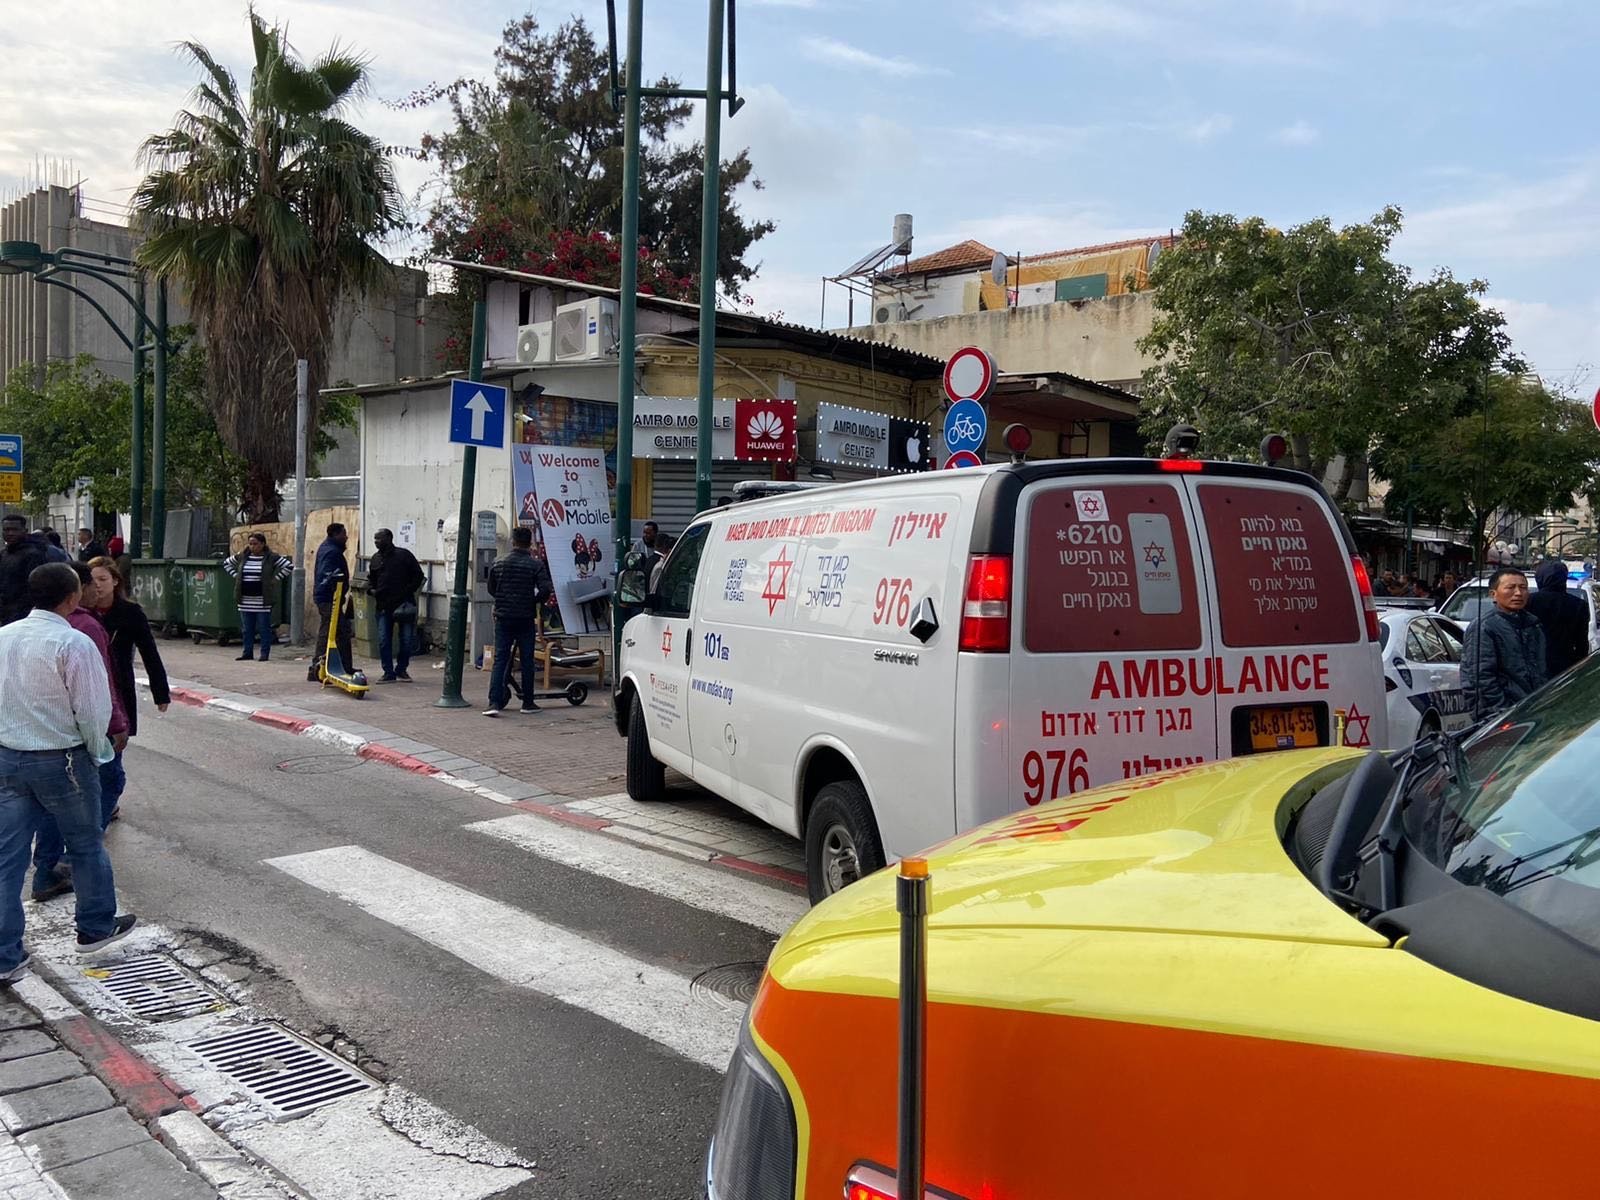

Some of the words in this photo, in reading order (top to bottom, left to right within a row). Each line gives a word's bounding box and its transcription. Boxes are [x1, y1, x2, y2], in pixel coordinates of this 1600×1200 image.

[633, 414, 674, 428] AMRO
[677, 415, 732, 428] MOLE
[833, 420, 857, 435] AMRO
[858, 424, 886, 440] MOBILE
[654, 435, 699, 448] CENTE
[747, 441, 785, 450] HUAWEI
[844, 443, 875, 459] CENTER
[538, 453, 600, 468] Welcome
[564, 469, 579, 482] to
[565, 509, 610, 526] Mobile
[725, 523, 749, 541] MAGEN
[746, 520, 769, 540] DAVID
[767, 517, 791, 538] ADOM
[799, 513, 831, 536] UNITED
[829, 508, 877, 533] KINGDOM
[1240, 514, 1275, 532] להיות
[1280, 517, 1304, 532] בוא
[888, 511, 948, 547] איילון
[1241, 536, 1273, 551] חיים
[1275, 536, 1308, 554] נאמן
[730, 558, 748, 569] MAGEN
[818, 556, 833, 571] דוד
[832, 555, 850, 572] מגן
[1059, 550, 1103, 565] חפשו
[1109, 550, 1127, 565] או
[727, 569, 743, 580] DAVID
[820, 573, 847, 589] אדום
[1087, 567, 1130, 587] בגוגל
[1284, 574, 1316, 591] ותציל
[725, 580, 742, 591] ADOM
[1248, 577, 1262, 591] מי
[1265, 577, 1283, 591] את
[729, 591, 745, 602] ISRAEL
[805, 587, 842, 608] בישראל
[873, 577, 913, 628] 976
[1062, 592, 1093, 608] חיים
[1096, 592, 1132, 612] נאמן
[1253, 594, 1280, 615] אליך
[1282, 596, 1318, 612] שקרוב
[704, 632, 722, 659] 101
[1090, 653, 1330, 700] AMBULANCE
[691, 678, 734, 705] www.mdais.org
[1041, 710, 1097, 737] אדום
[1107, 709, 1146, 734] דוד
[1155, 707, 1192, 737] מגן
[1022, 747, 1090, 806] 976
